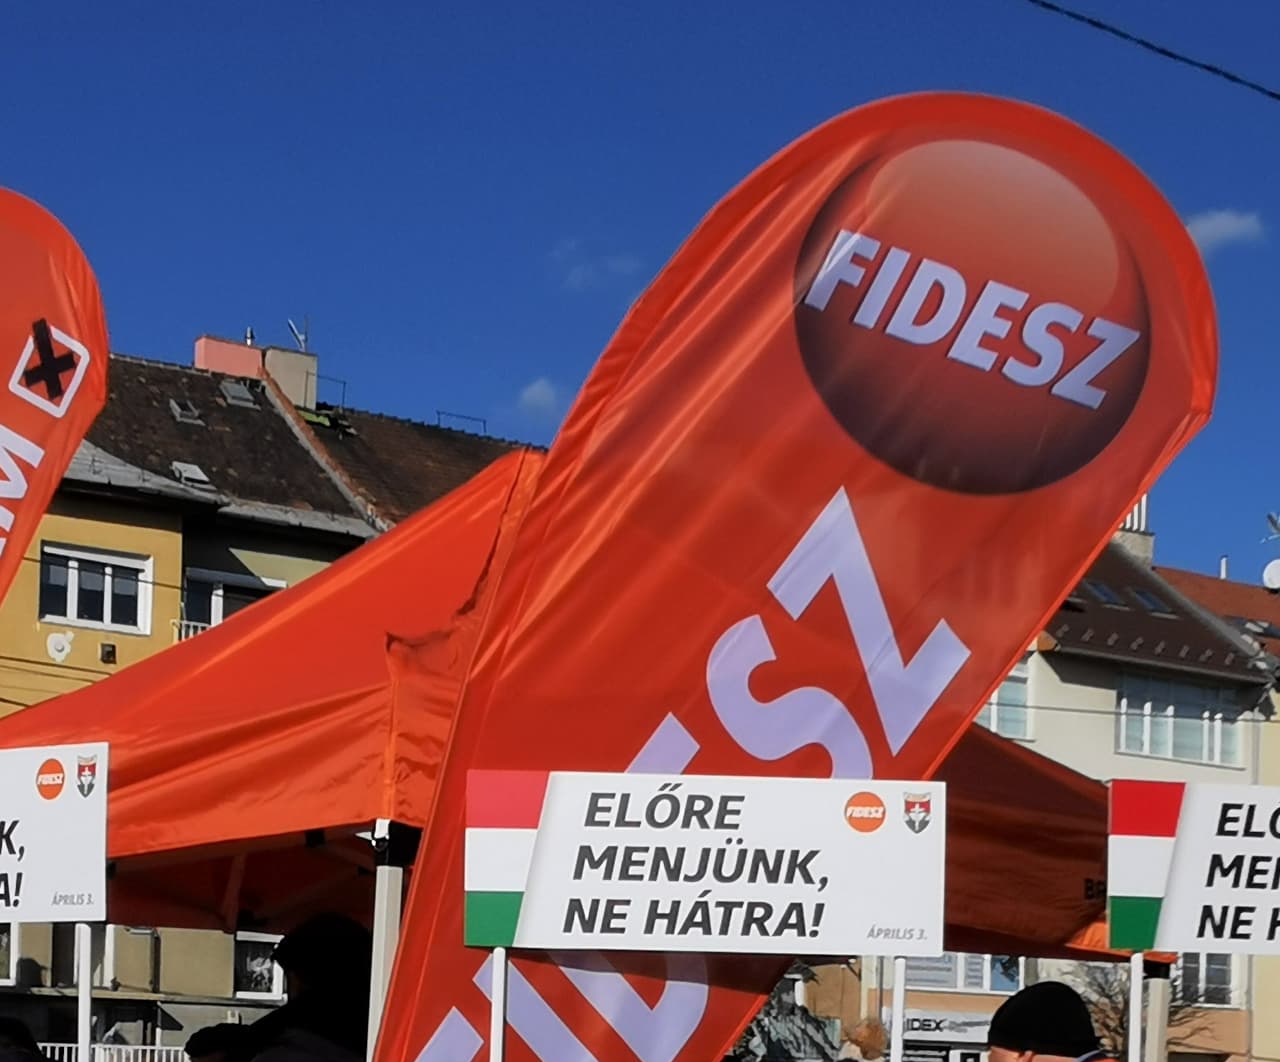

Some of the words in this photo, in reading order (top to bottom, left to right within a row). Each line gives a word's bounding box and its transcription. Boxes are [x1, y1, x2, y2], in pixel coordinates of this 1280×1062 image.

[804, 228, 1141, 411] FIDESZ
[584, 783, 746, 830] ELŐRE
[573, 838, 828, 893] MENJÜNK,
[562, 898, 632, 934] NE
[643, 888, 825, 938] HÁTRA!
[867, 924, 915, 940] ÁPRILIS
[916, 929, 928, 941] 3.
[1197, 905, 1257, 940] NE
